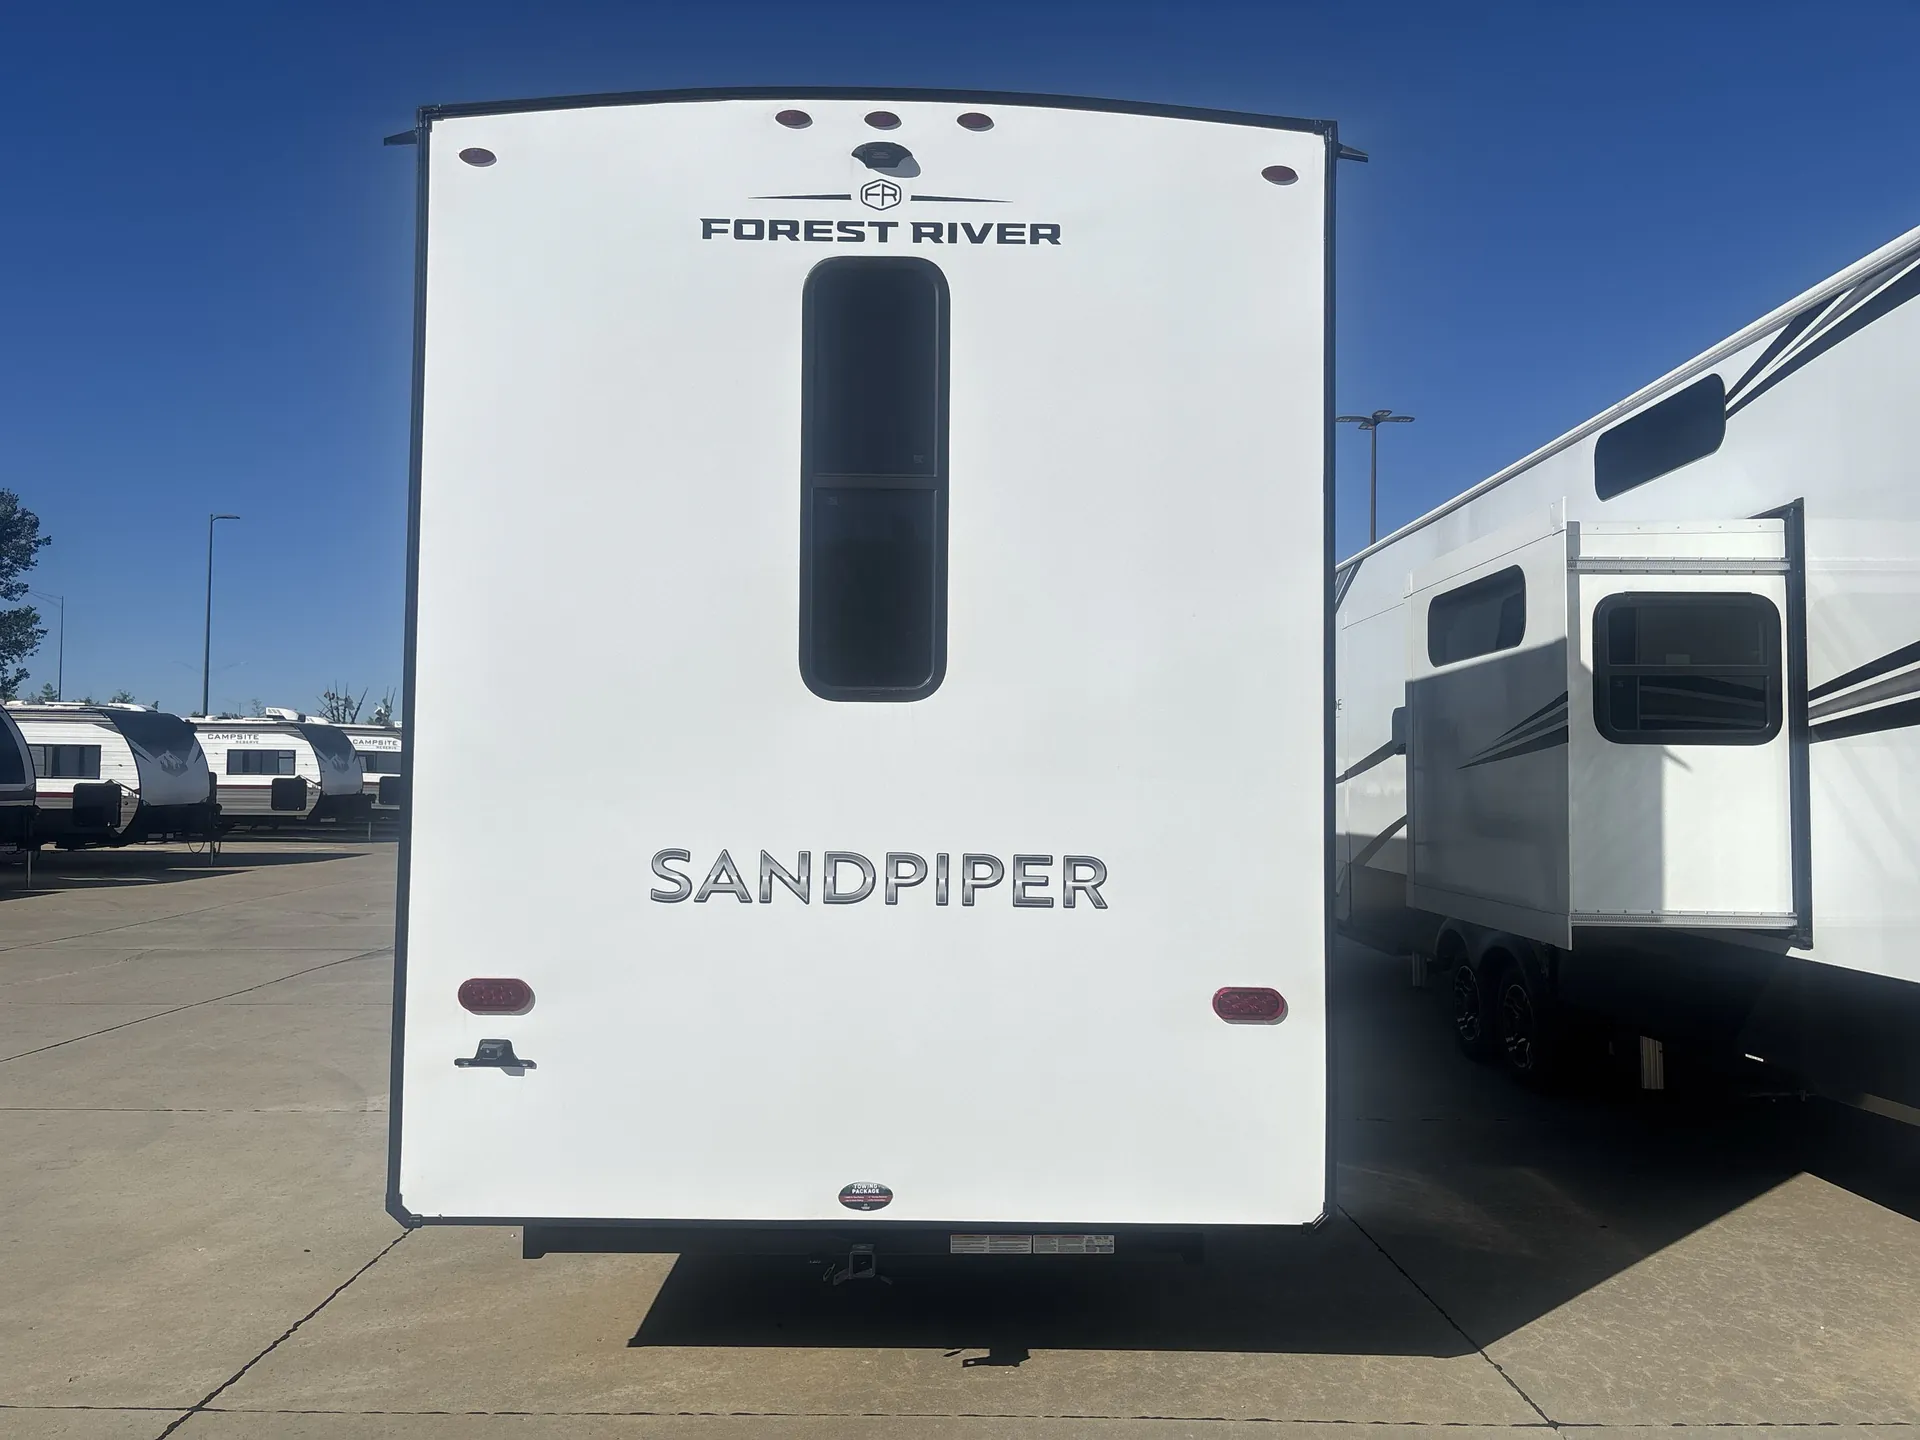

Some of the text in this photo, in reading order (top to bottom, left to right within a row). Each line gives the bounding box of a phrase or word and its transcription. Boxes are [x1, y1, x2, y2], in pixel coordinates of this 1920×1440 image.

[700, 218, 1062, 246] FOREST RIVER
[650, 848, 1109, 909] SANDPIPER
